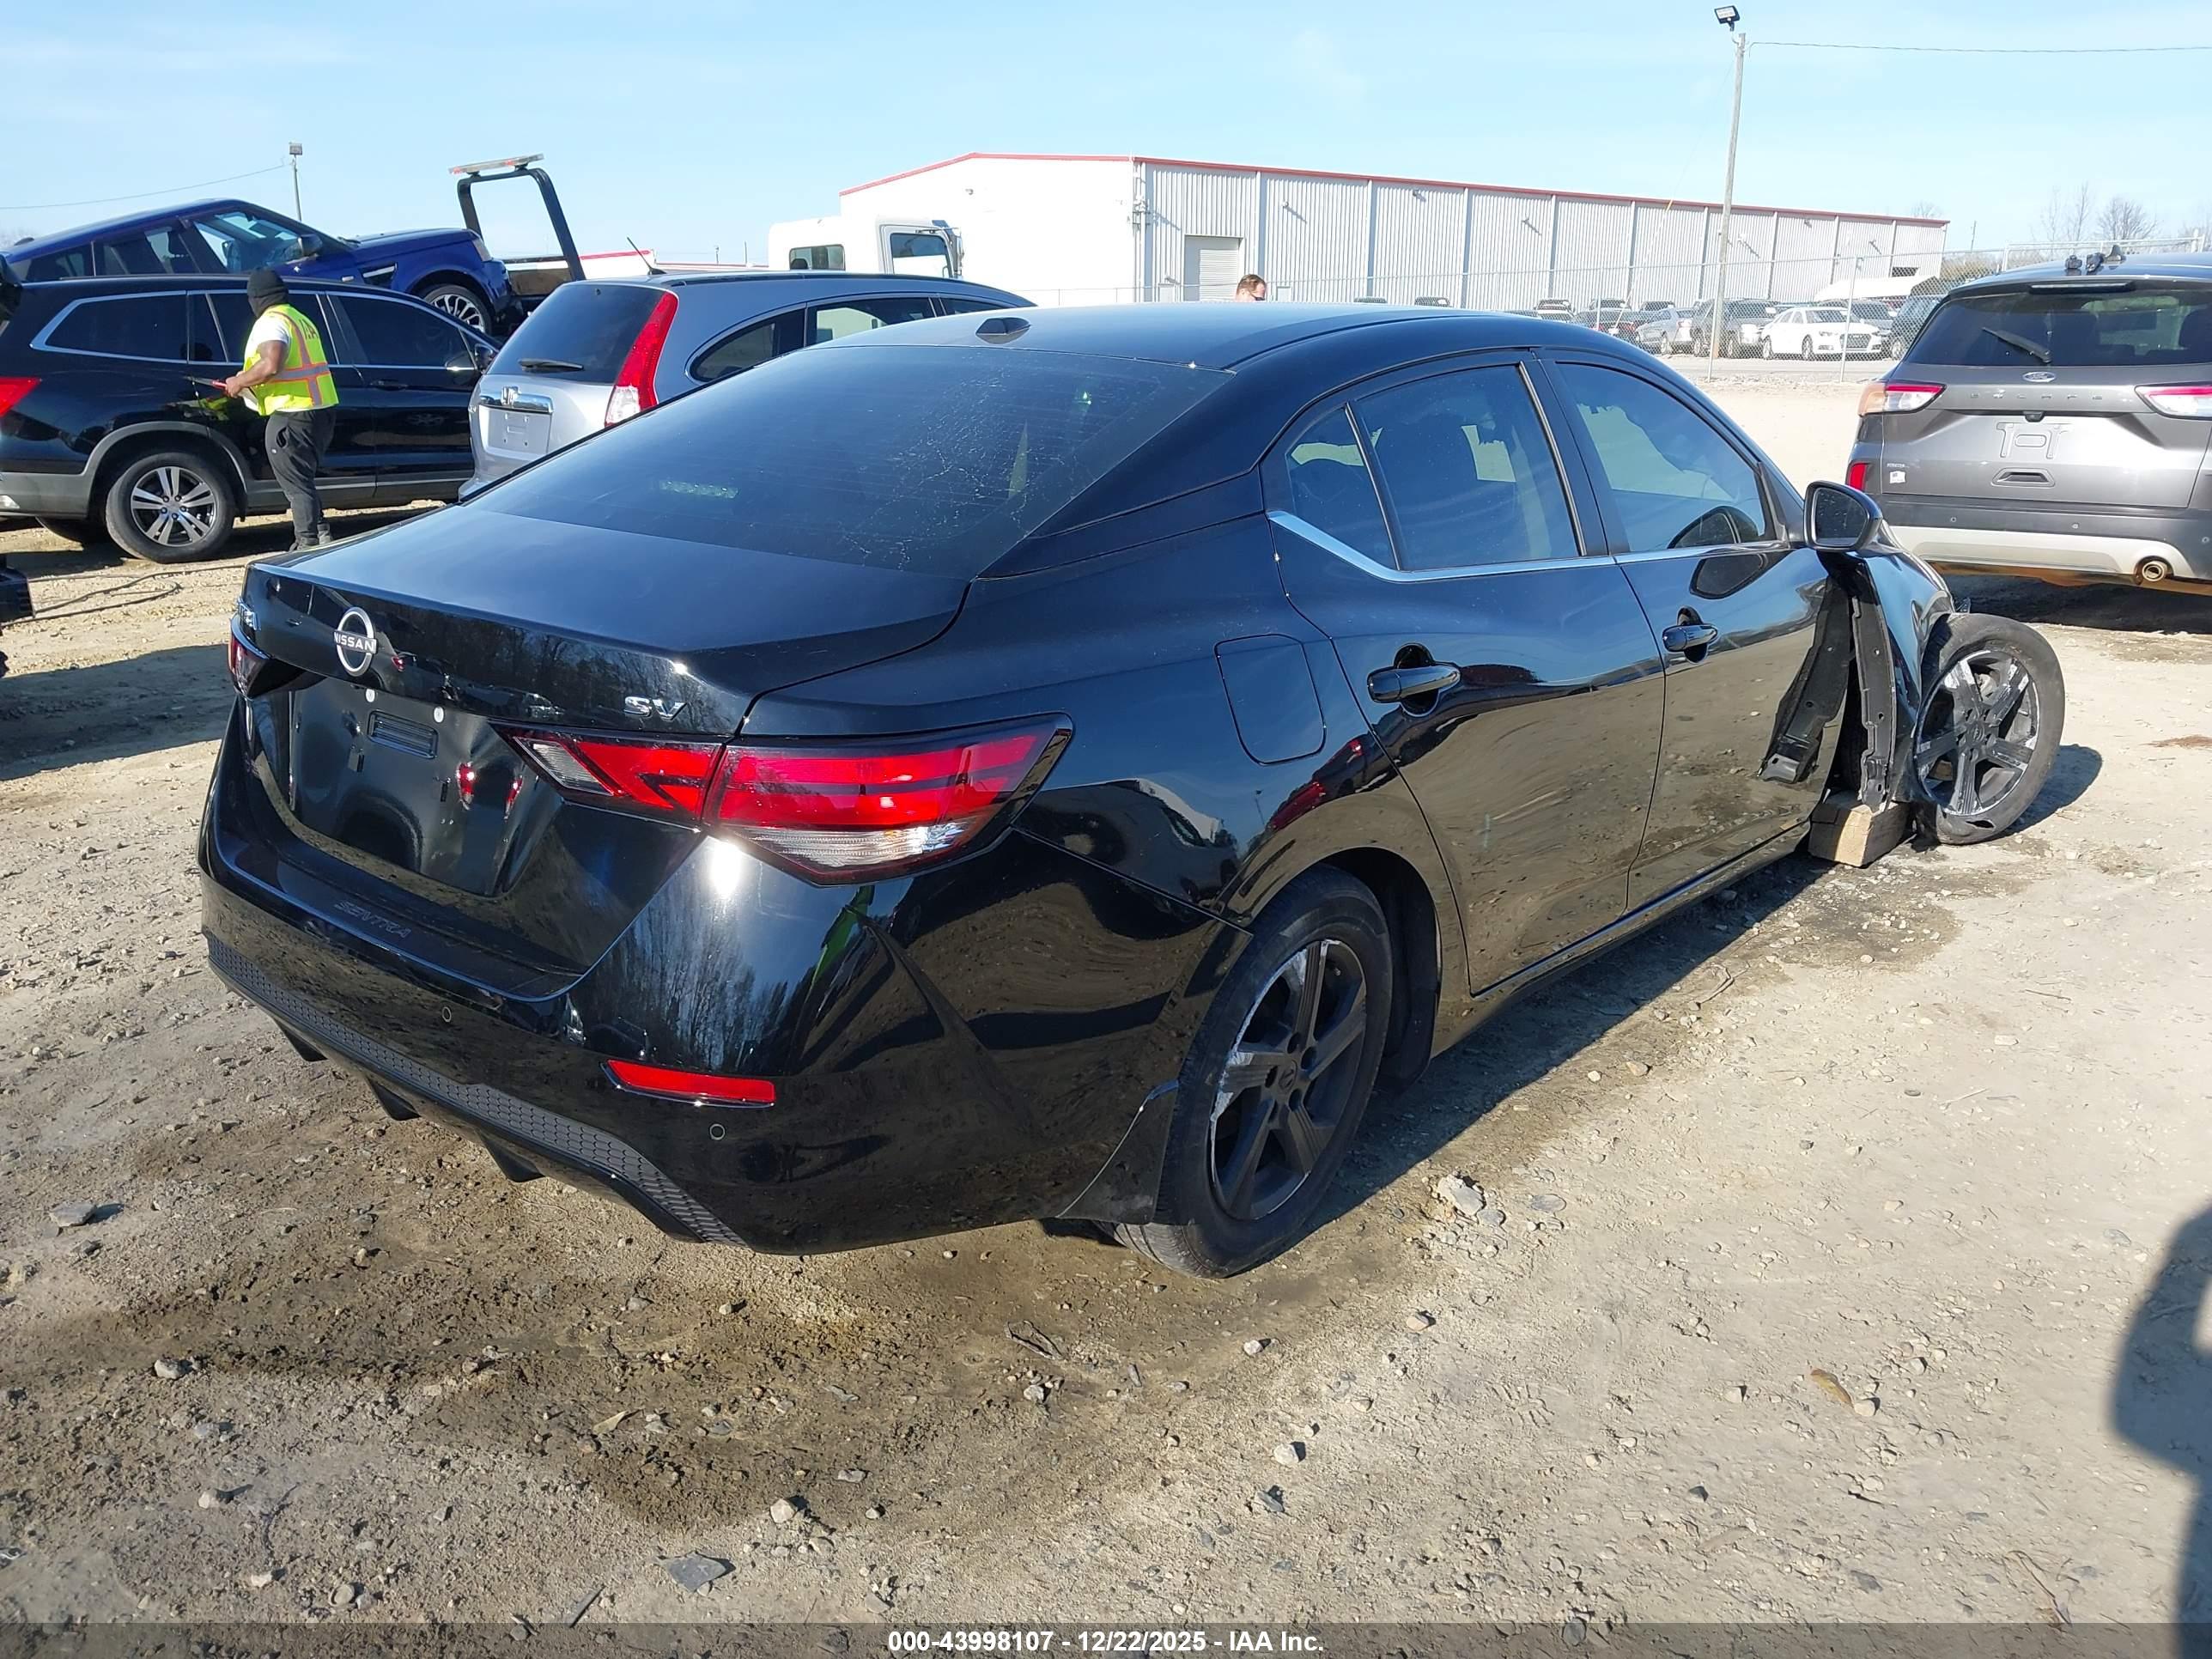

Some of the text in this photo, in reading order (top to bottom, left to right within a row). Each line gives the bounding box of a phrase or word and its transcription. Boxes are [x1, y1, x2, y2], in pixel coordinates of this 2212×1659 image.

[334, 632, 376, 653] NISSAN
[623, 696, 687, 720] SV
[333, 900, 411, 938] SENTRA
